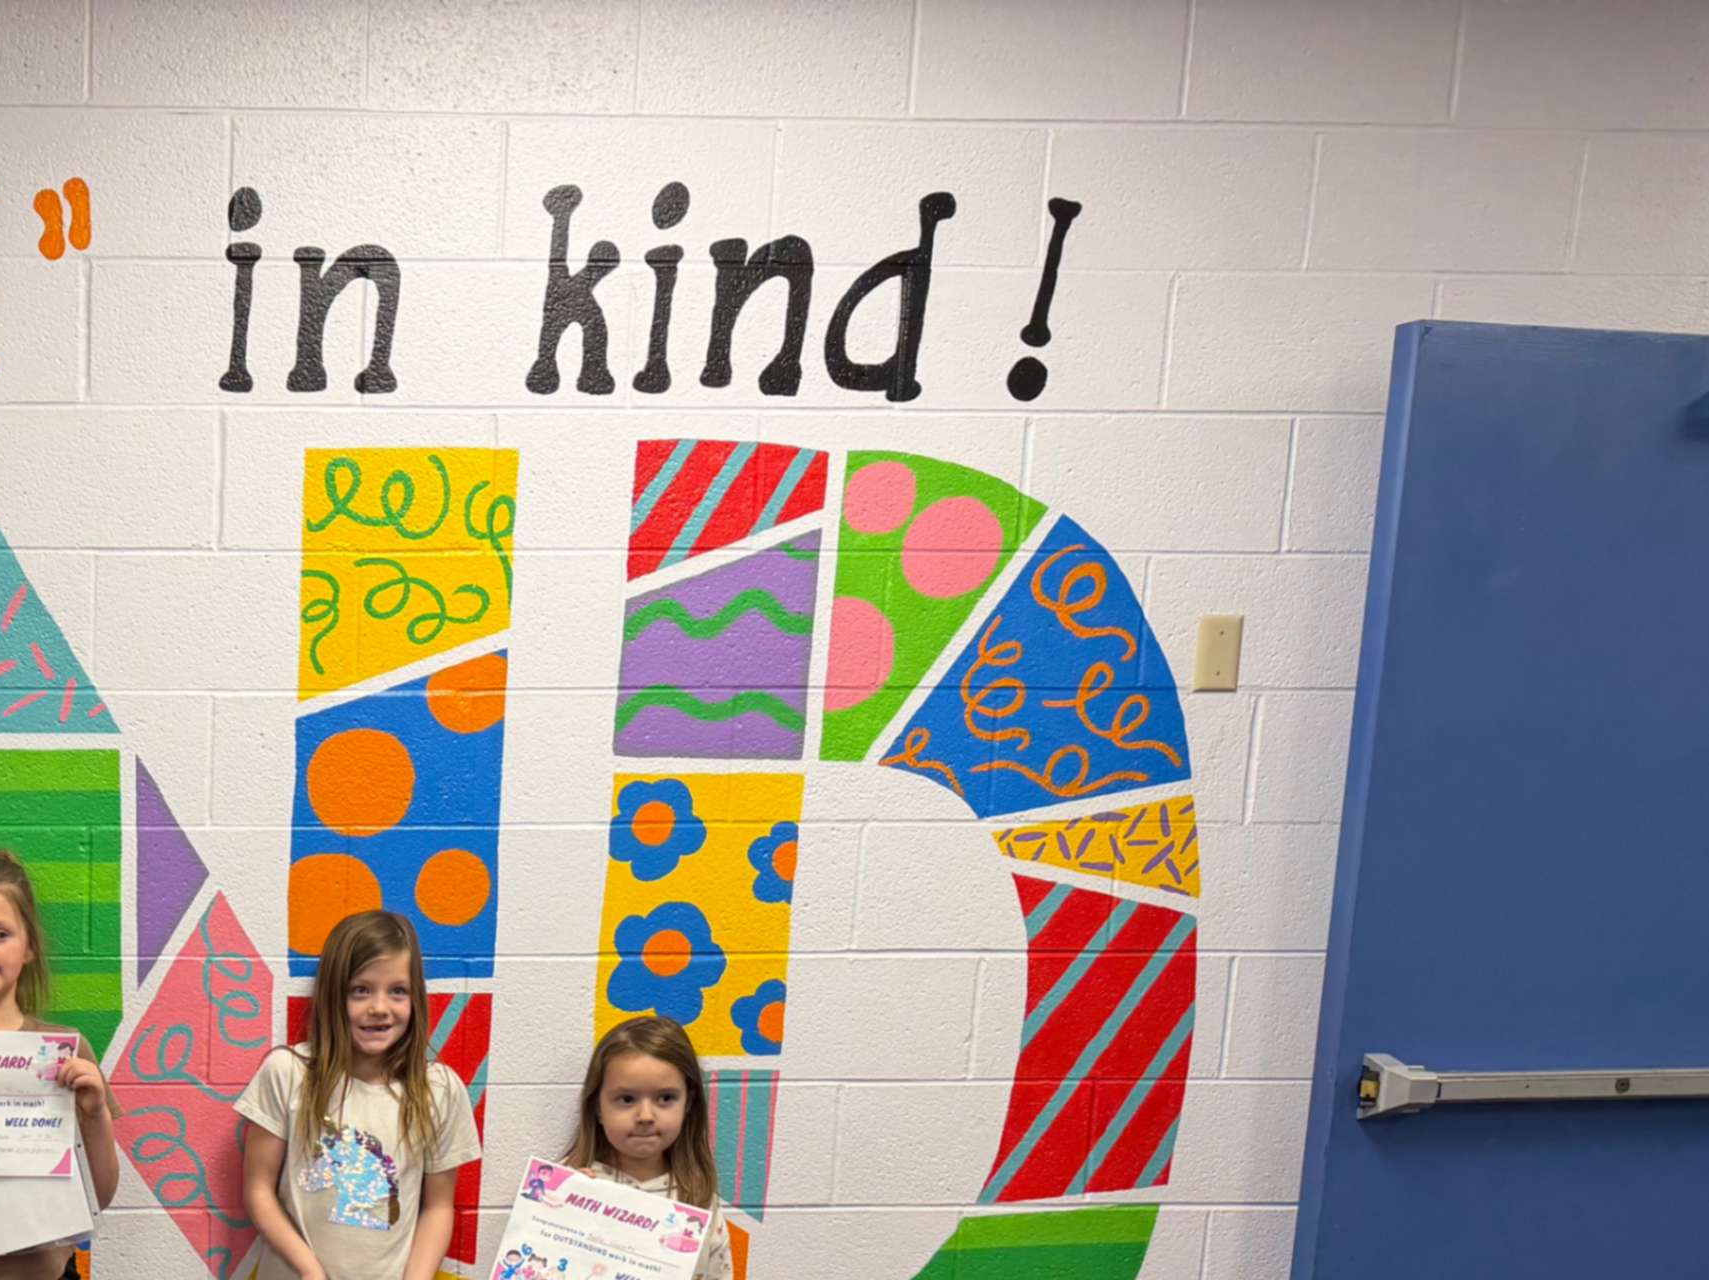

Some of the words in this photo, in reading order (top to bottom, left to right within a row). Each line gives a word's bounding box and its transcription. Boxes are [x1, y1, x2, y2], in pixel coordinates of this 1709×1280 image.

[218, 185, 401, 393] in
[4, 1117, 29, 1128] WELL
[31, 1117, 62, 1128] DONE!
[564, 1193, 602, 1213] MATH
[602, 1202, 659, 1231] WIZARD!
[557, 1258, 568, 1272] 3
